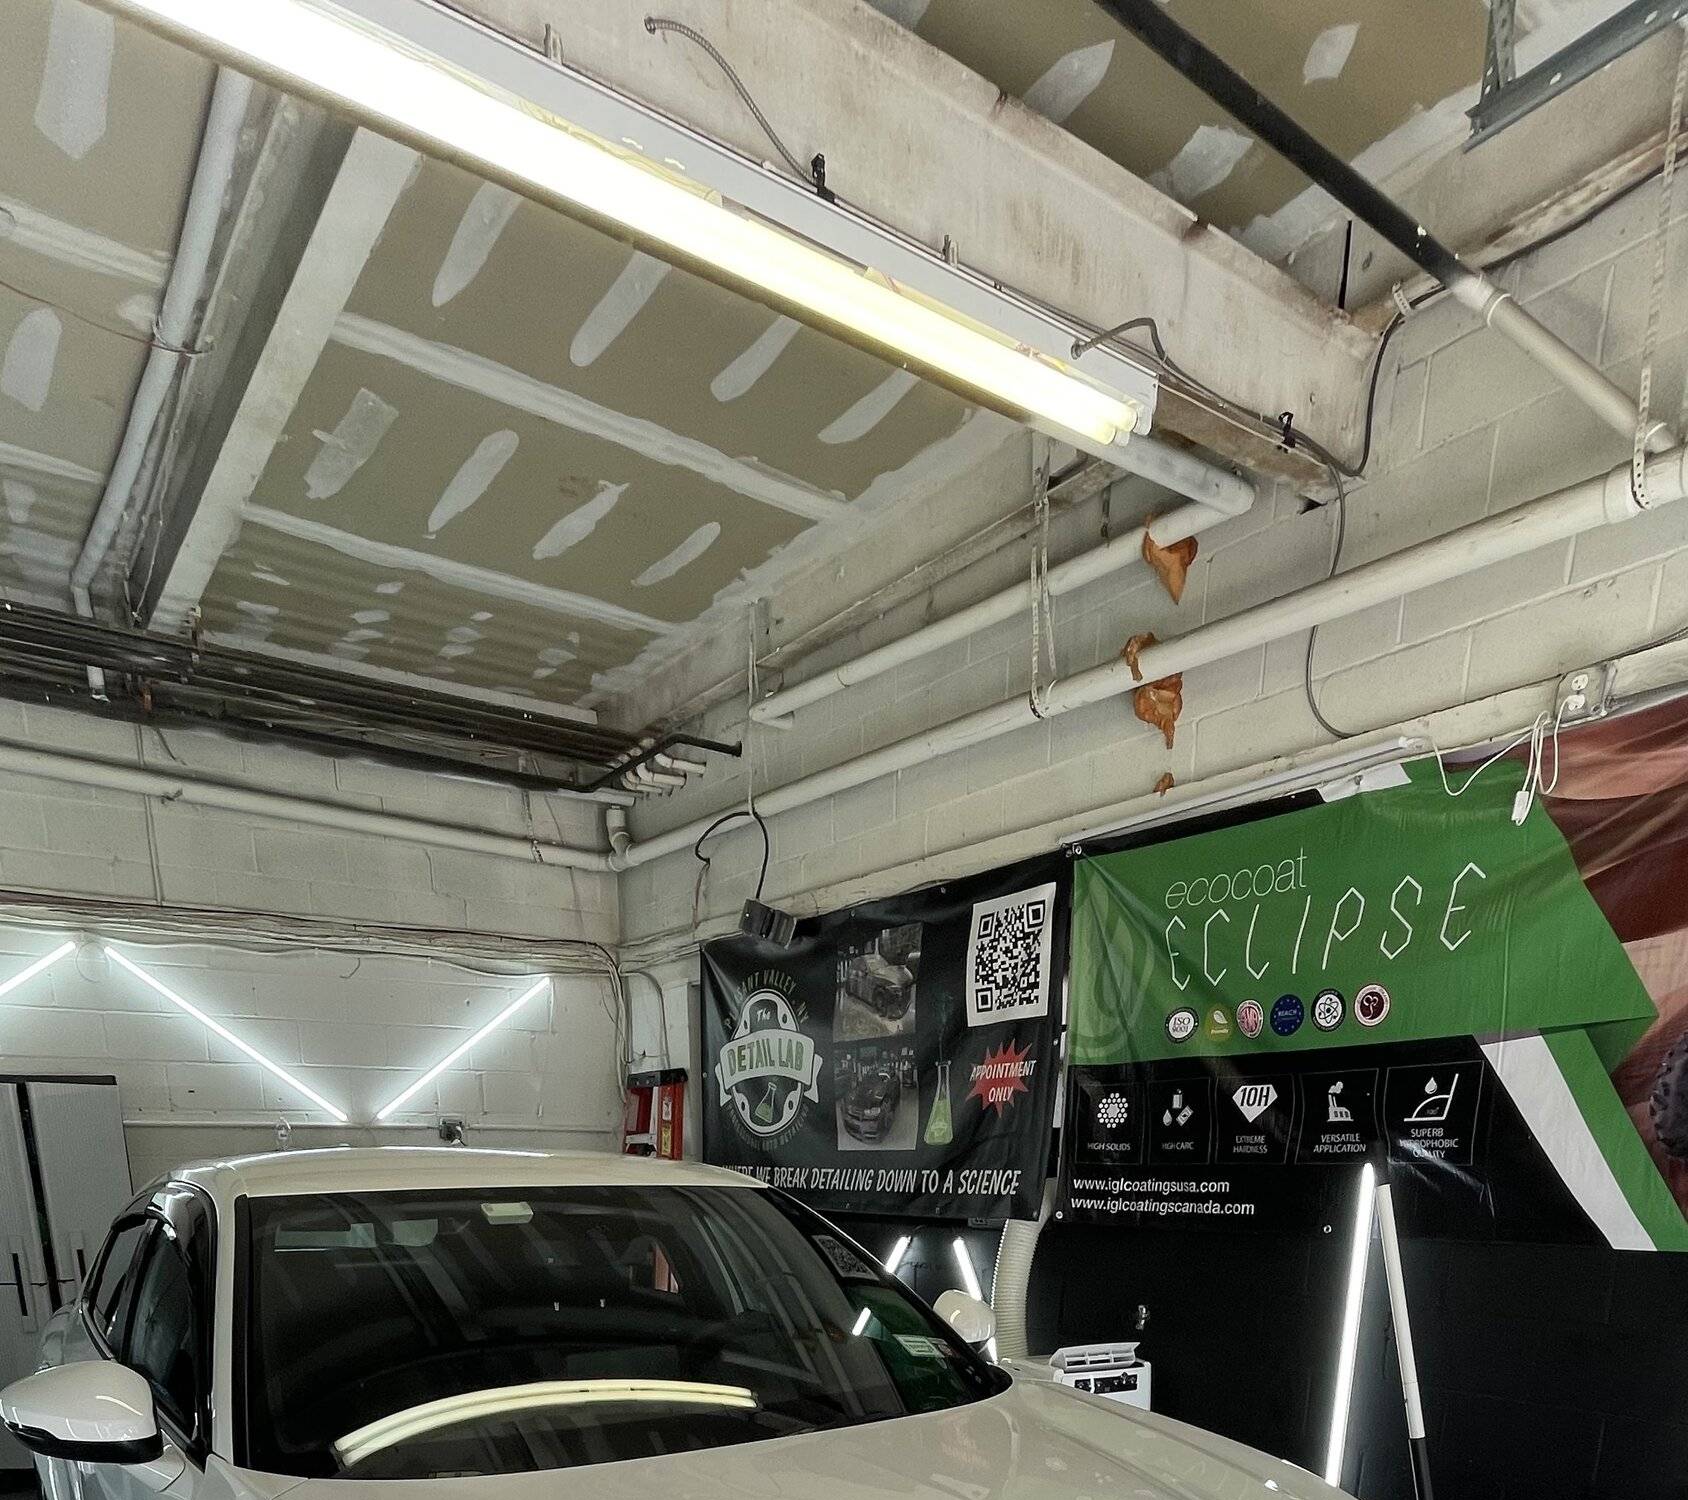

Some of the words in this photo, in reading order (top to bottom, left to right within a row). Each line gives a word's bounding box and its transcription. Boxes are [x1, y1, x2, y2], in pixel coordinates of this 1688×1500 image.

[1165, 847, 1307, 910] ecocoat
[1165, 861, 1487, 991] ECLIPSE
[763, 968, 798, 995] VALLEY
[756, 1008, 771, 1023] The
[1173, 1016, 1191, 1026] ISO
[727, 1037, 776, 1077] DETAIL
[778, 1037, 805, 1072] LAB
[969, 1060, 1037, 1081] APPOINTMENT
[988, 1086, 1014, 1102] ONLY
[1240, 1086, 1271, 1107] 10H
[1235, 1136, 1266, 1144] EXTREME
[1321, 1133, 1361, 1143] VERSATILE
[1411, 1128, 1444, 1138] SUPERB
[1106, 1143, 1131, 1151] SOLIDS
[1313, 1143, 1367, 1153] APPLICATION
[774, 1168, 807, 1189] BREAK
[811, 1168, 873, 1191] DETAILING
[876, 1169, 917, 1193] DOWN
[921, 1169, 940, 1193] TO
[943, 1170, 954, 1194] A
[957, 1169, 1022, 1196] SCIENCE
[1073, 1177, 1230, 1196] www.iglcoatingsusa.com
[1071, 1197, 1256, 1216] www.iglcoatingscanada.com
